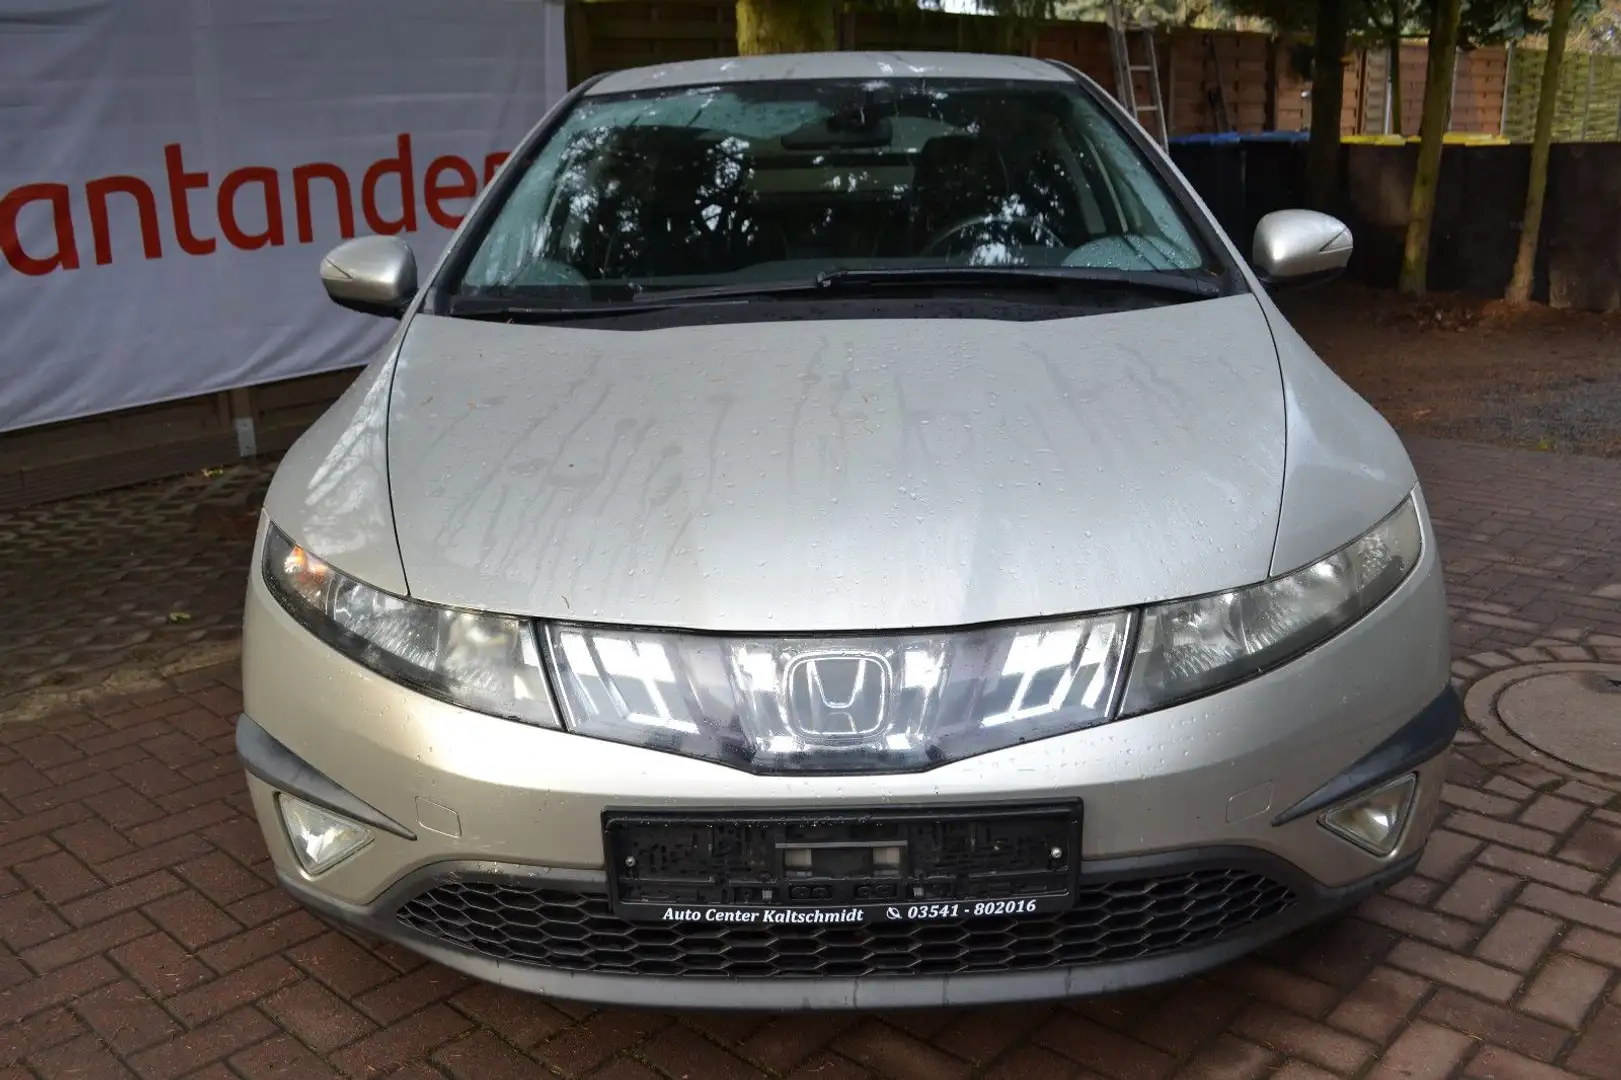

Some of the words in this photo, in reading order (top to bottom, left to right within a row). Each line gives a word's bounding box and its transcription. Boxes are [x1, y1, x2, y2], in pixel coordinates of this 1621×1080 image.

[662, 907, 701, 921] Auto
[705, 908, 760, 922] Center
[762, 908, 864, 923] Kaltschmidt
[907, 904, 959, 919] 03541
[973, 899, 1037, 916] 802016
